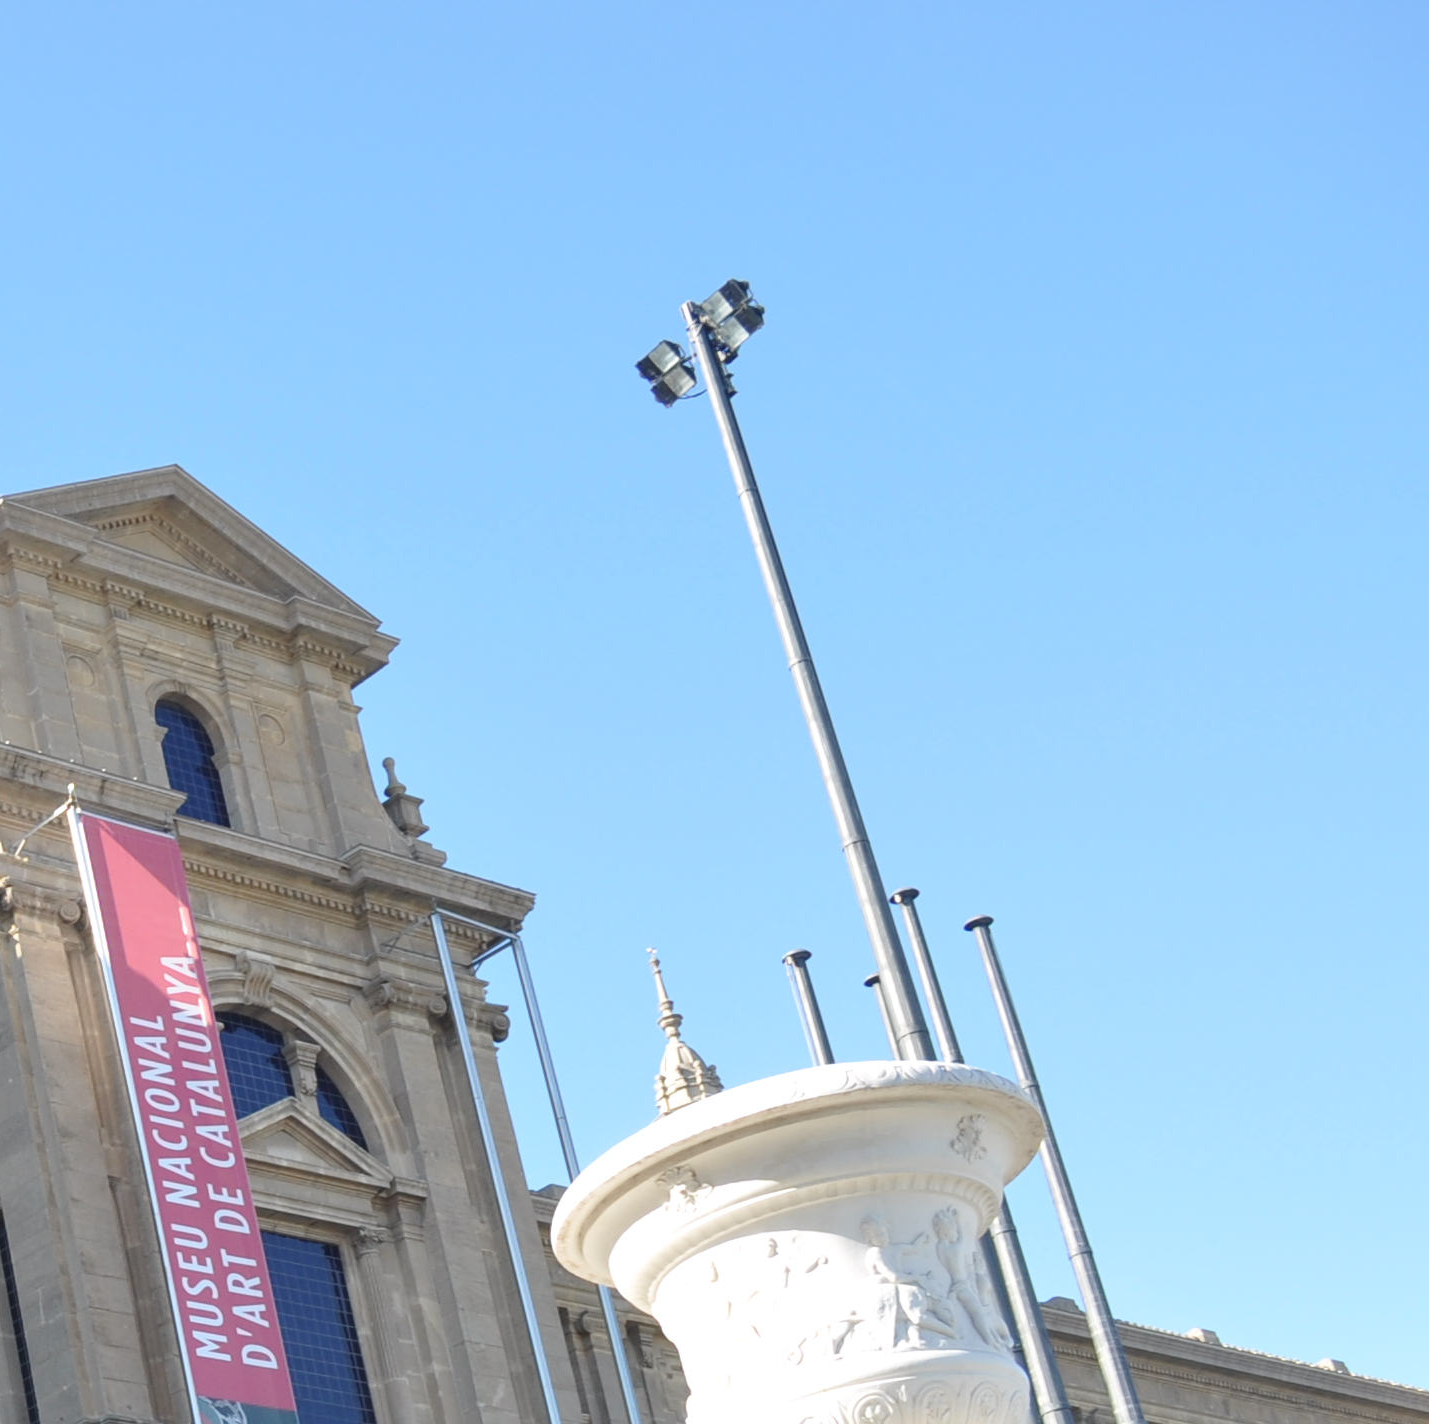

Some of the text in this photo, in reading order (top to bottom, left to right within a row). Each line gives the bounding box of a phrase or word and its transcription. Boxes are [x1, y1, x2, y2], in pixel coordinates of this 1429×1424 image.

[129, 1015, 232, 1362] MUSEU NACIONAL
[161, 954, 278, 1370] D'ART DE CATALUNYA
